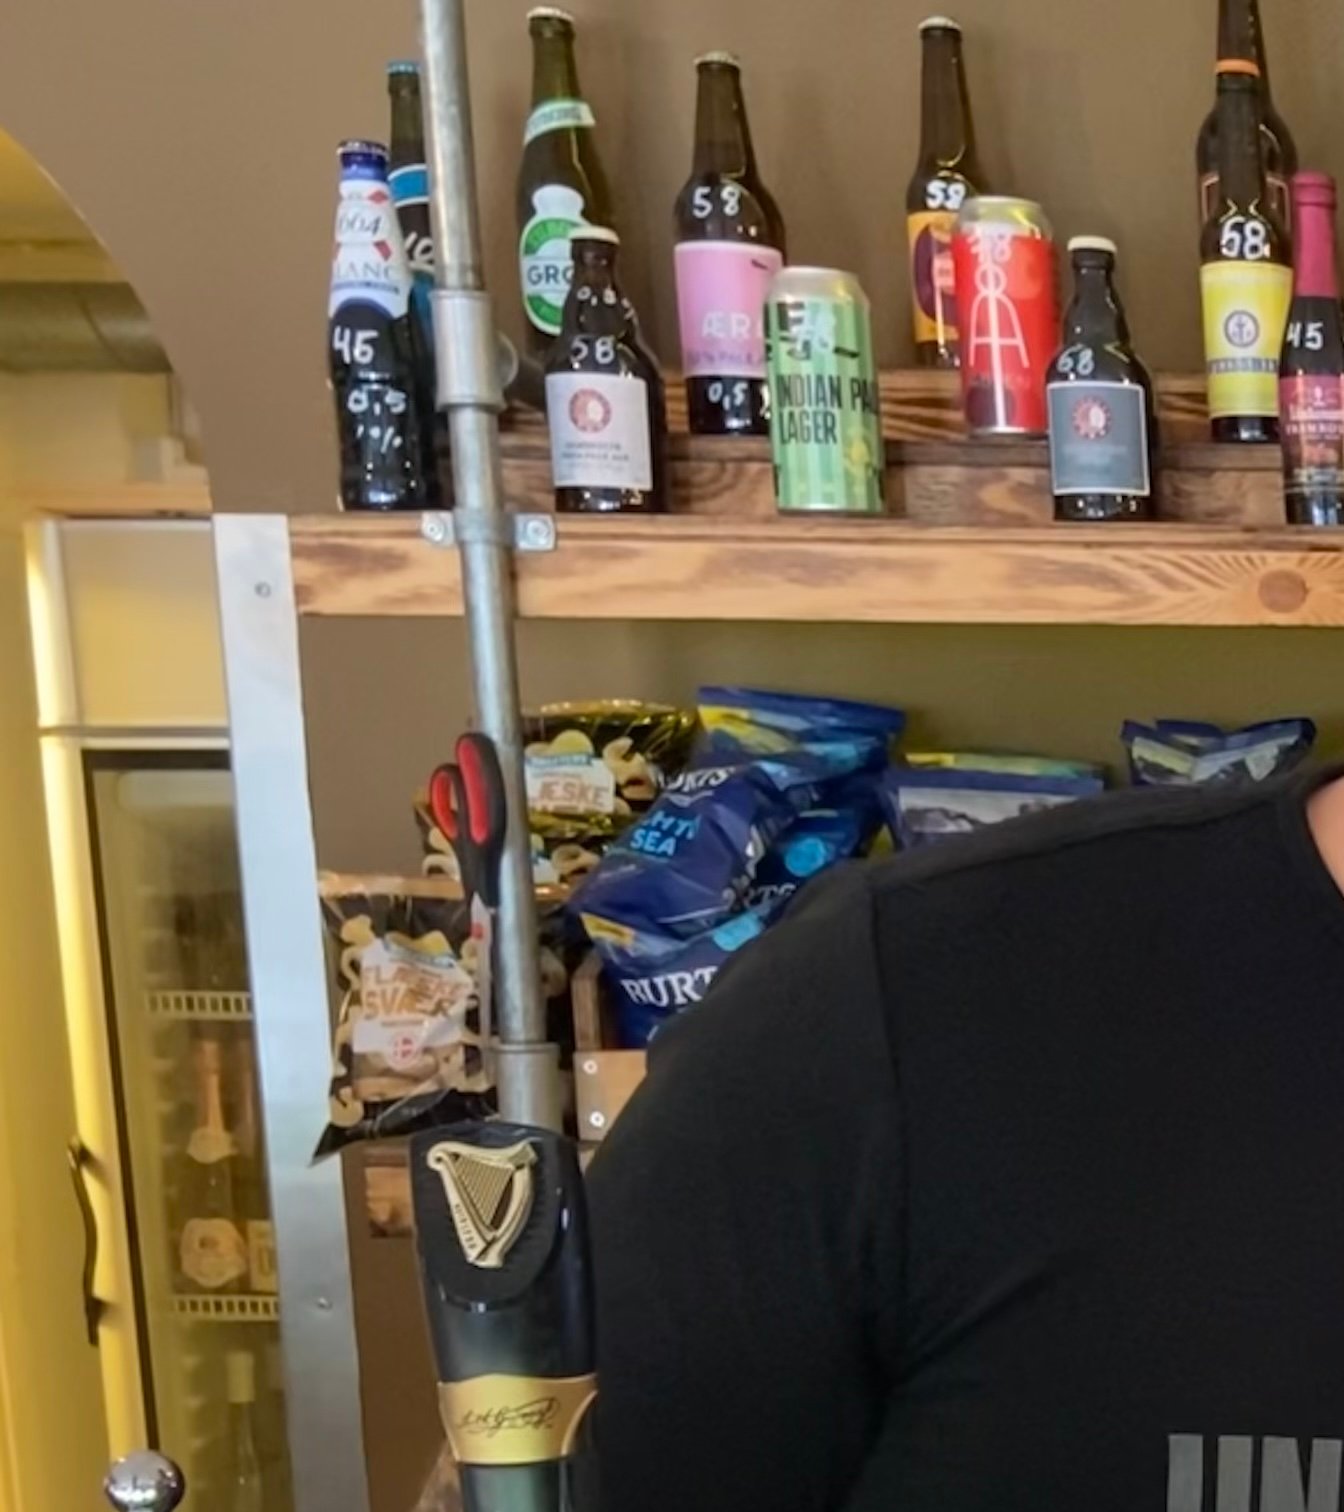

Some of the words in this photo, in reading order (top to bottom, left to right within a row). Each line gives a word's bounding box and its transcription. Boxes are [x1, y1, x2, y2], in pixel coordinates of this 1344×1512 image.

[692, 185, 741, 218] 58
[1221, 216, 1268, 259] 68
[1286, 321, 1324, 350] 45
[1057, 346, 1096, 374] 68
[779, 409, 839, 446] LAGER
[629, 828, 677, 856] SEA
